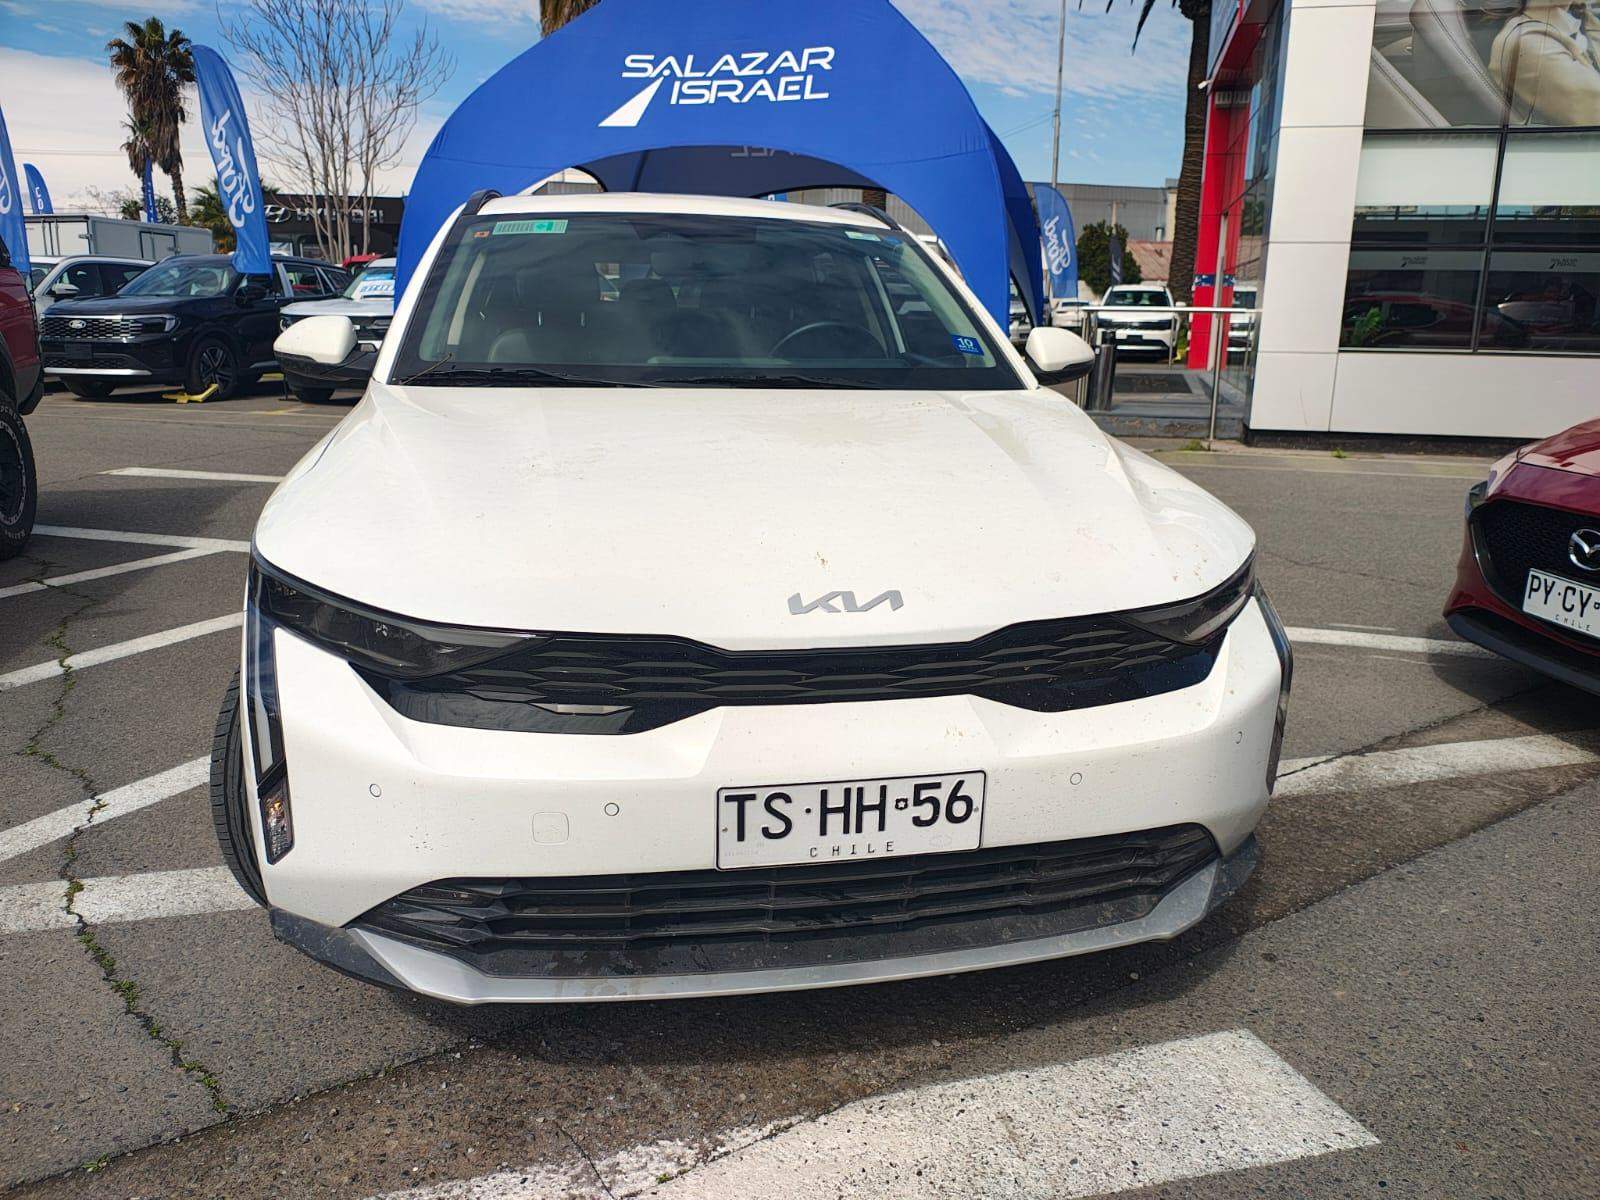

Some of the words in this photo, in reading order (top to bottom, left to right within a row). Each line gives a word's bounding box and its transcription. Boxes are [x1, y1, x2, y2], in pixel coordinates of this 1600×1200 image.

[621, 46, 835, 78] SALAZAR
[670, 74, 830, 105] ISRAEL
[809, 841, 895, 858] CHILE
